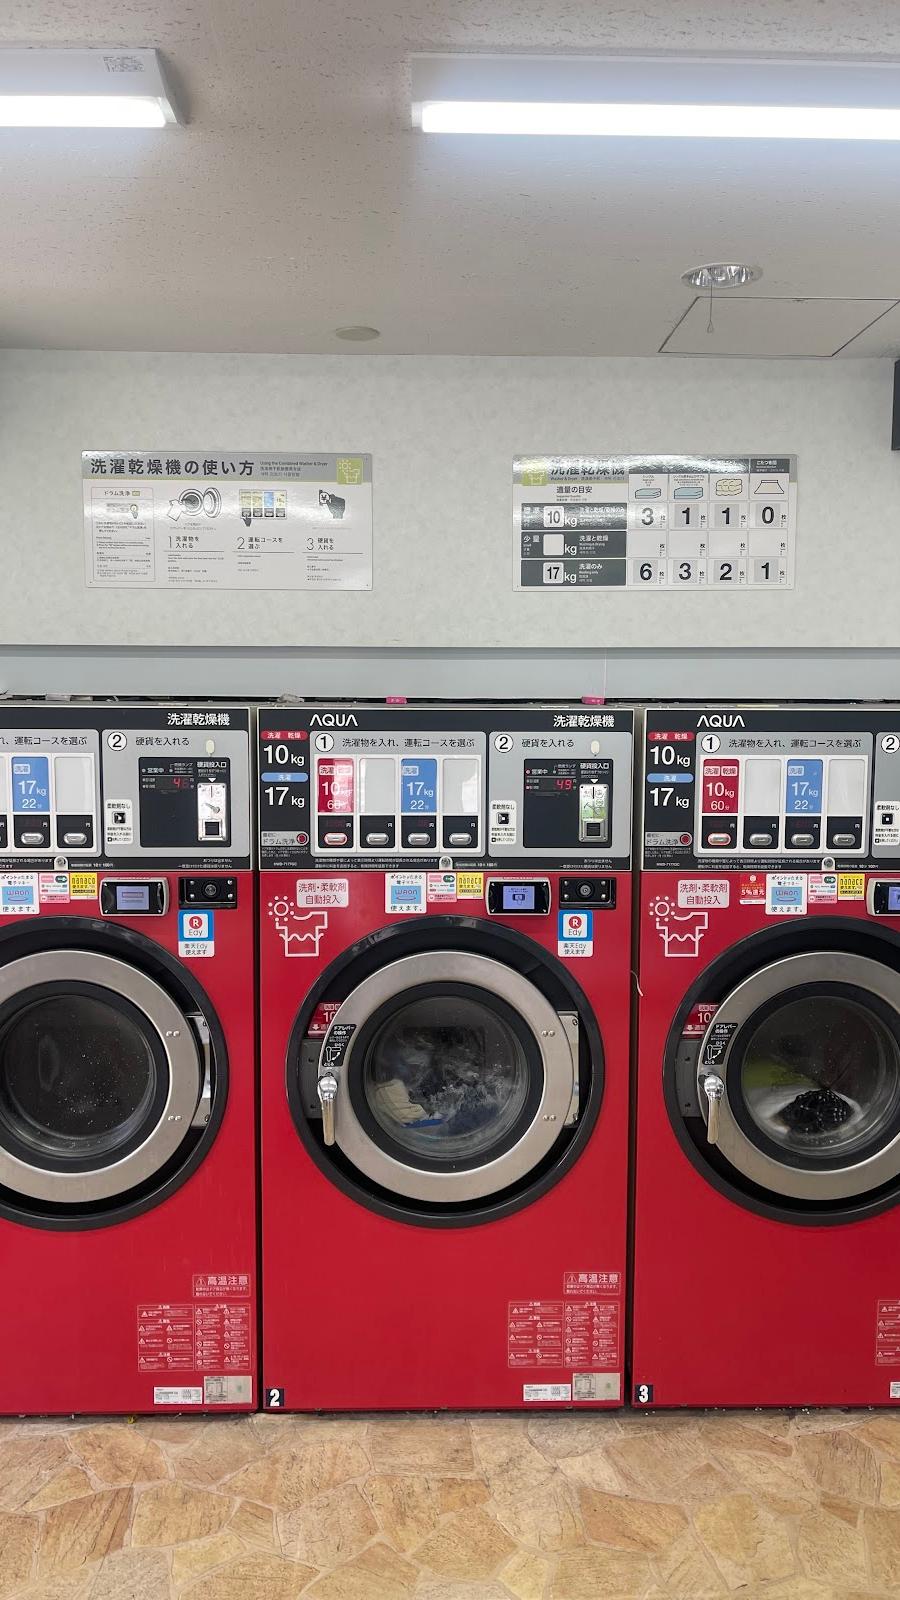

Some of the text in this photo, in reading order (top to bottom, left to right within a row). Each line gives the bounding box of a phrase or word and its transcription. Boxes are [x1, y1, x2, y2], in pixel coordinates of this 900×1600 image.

[91, 458, 255, 476] 洗濯乾燥機の使い方
[556, 485, 593, 494] 適量の目安
[548, 511, 577, 527] 10 kg
[641, 507, 655, 526] 3
[681, 507, 691, 525] 1
[721, 507, 731, 525] 1
[761, 506, 775, 524] 0
[237, 537, 245, 549] 2
[306, 538, 314, 550] 3
[564, 543, 577, 555] kg
[546, 566, 560, 580] 17
[564, 571, 577, 583] kg
[640, 562, 653, 581] 6
[679, 562, 692, 580] 3
[720, 562, 733, 580] 2
[761, 562, 770, 580] 1
[167, 712, 231, 726] 洗濯乾燥機
[310, 713, 359, 727] AQUA
[553, 715, 615, 728] 洗濯乾燥機
[696, 714, 746, 728] AQUA
[135, 736, 190, 746] 硬貨を入れる
[342, 738, 475, 748] 洗濯物を入れ、運転コースを選ぶ
[521, 738, 575, 748] 硬貨を入れる
[728, 739, 862, 748] 洗濯物を入れ、運転コースを選ぶ
[298, 882, 347, 892] 洗剤・柔軟剤
[680, 883, 728, 893] 洗剤・柔軟剤
[306, 895, 341, 905] 自動投入
[686, 896, 721, 905] 自動投入
[568, 928, 582, 937] Edy
[207, 1275, 249, 1286] 高温注意
[578, 1273, 619, 1284] 高温注意
[270, 1388, 280, 1407] 2
[638, 1384, 649, 1403] 3
